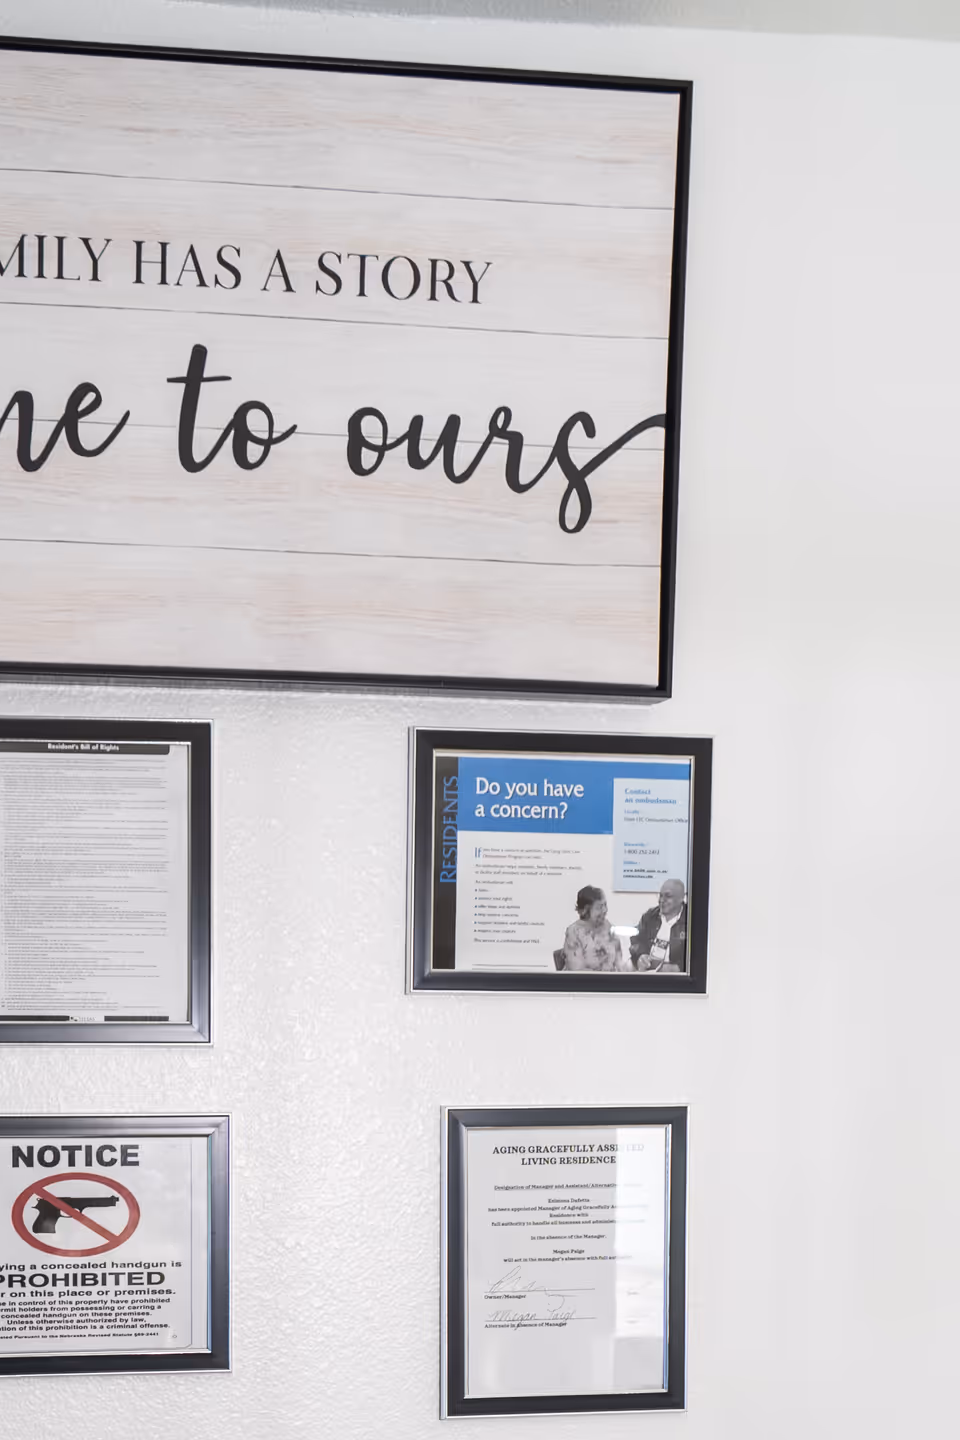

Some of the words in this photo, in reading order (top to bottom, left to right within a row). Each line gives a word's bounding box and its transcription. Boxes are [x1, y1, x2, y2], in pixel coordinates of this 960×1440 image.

[132, 239, 242, 290] HAS
[260, 248, 296, 293] A
[315, 251, 492, 304] STORY
[167, 343, 297, 473] to
[346, 405, 666, 534] ours
[475, 776, 501, 795] Do
[504, 782, 537, 800] you
[543, 778, 584, 797] have
[474, 803, 486, 817] a
[489, 801, 568, 819] concern?
[440, 775, 458, 883] RESIDENTS
[11, 1144, 140, 1168] NOTICE
[492, 1145, 526, 1155] AGING
[527, 1144, 595, 1154] GRACEFULLY
[521, 1157, 557, 1166] LIVING
[559, 1155, 616, 1165] RESIDENCE
[40, 1261, 107, 1270] concealed
[111, 1261, 167, 1270] handgun
[29, 1289, 54, 1297] this
[58, 1289, 93, 1298] place
[114, 1287, 176, 1297] premises.
[130, 1297, 171, 1305] prohibited
